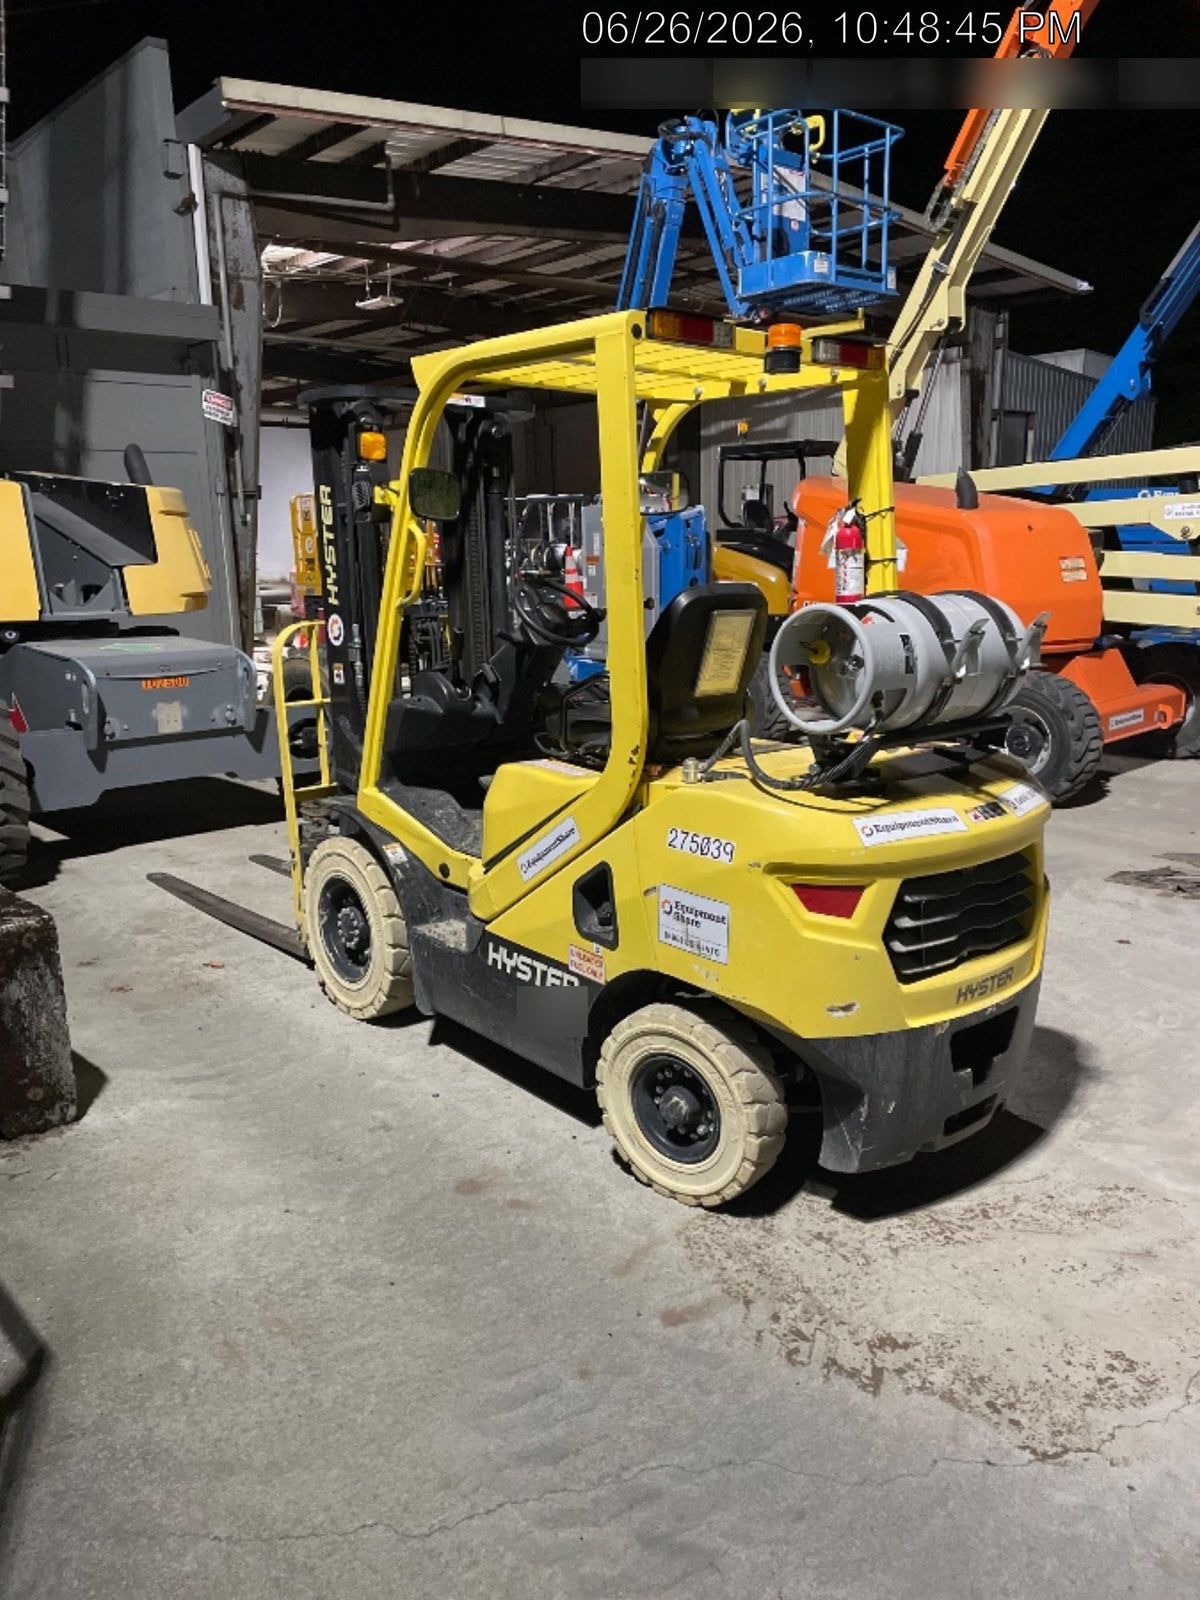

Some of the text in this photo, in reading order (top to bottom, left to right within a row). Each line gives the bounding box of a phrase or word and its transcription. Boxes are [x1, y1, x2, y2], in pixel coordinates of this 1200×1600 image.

[319, 484, 340, 606] HYSTER
[673, 911, 701, 928] Share
[674, 900, 727, 926] Equipment
[956, 966, 1014, 1006] HYSTER
